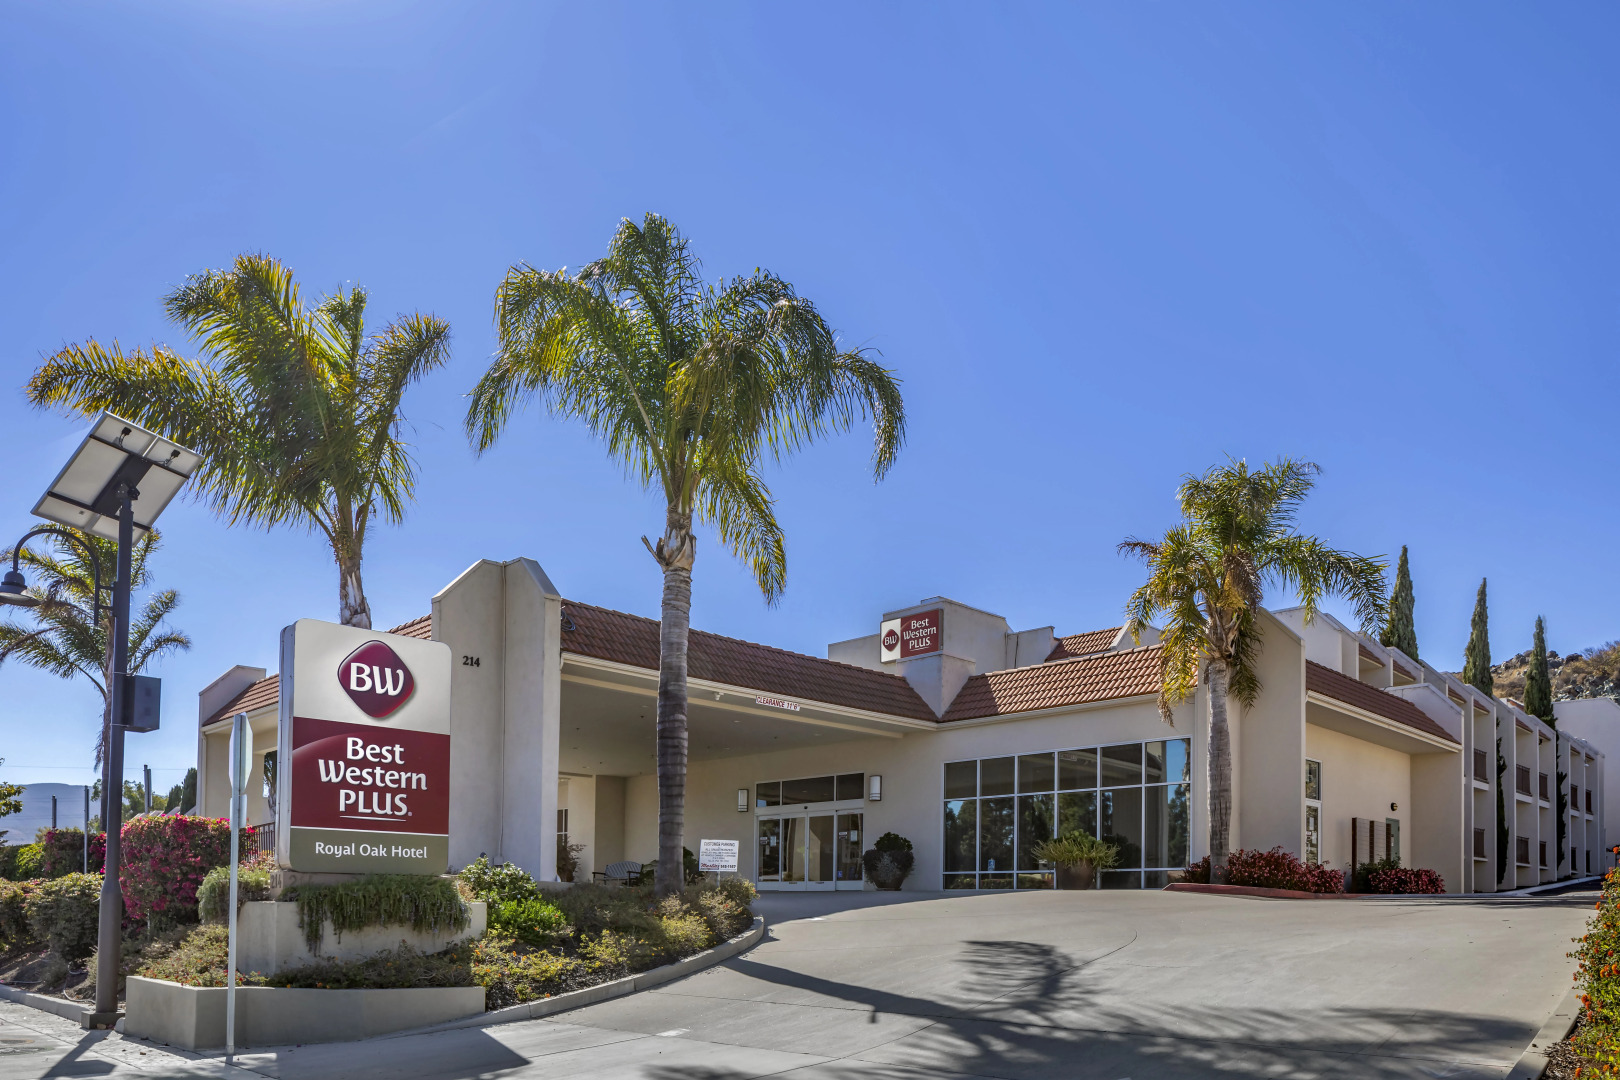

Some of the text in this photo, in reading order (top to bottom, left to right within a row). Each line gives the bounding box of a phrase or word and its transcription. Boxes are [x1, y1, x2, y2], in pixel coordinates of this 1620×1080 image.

[911, 618, 929, 629] Best
[884, 635, 897, 645] BW
[903, 627, 937, 640] Western
[909, 637, 931, 649] PLUS
[462, 655, 480, 667] 214
[350, 662, 405, 696] BW
[757, 696, 785, 707] CLEARANCE
[346, 737, 405, 764] Best
[318, 759, 428, 791] Western
[339, 789, 408, 816] PLUS
[315, 842, 428, 858] Royal Oak Hotel
